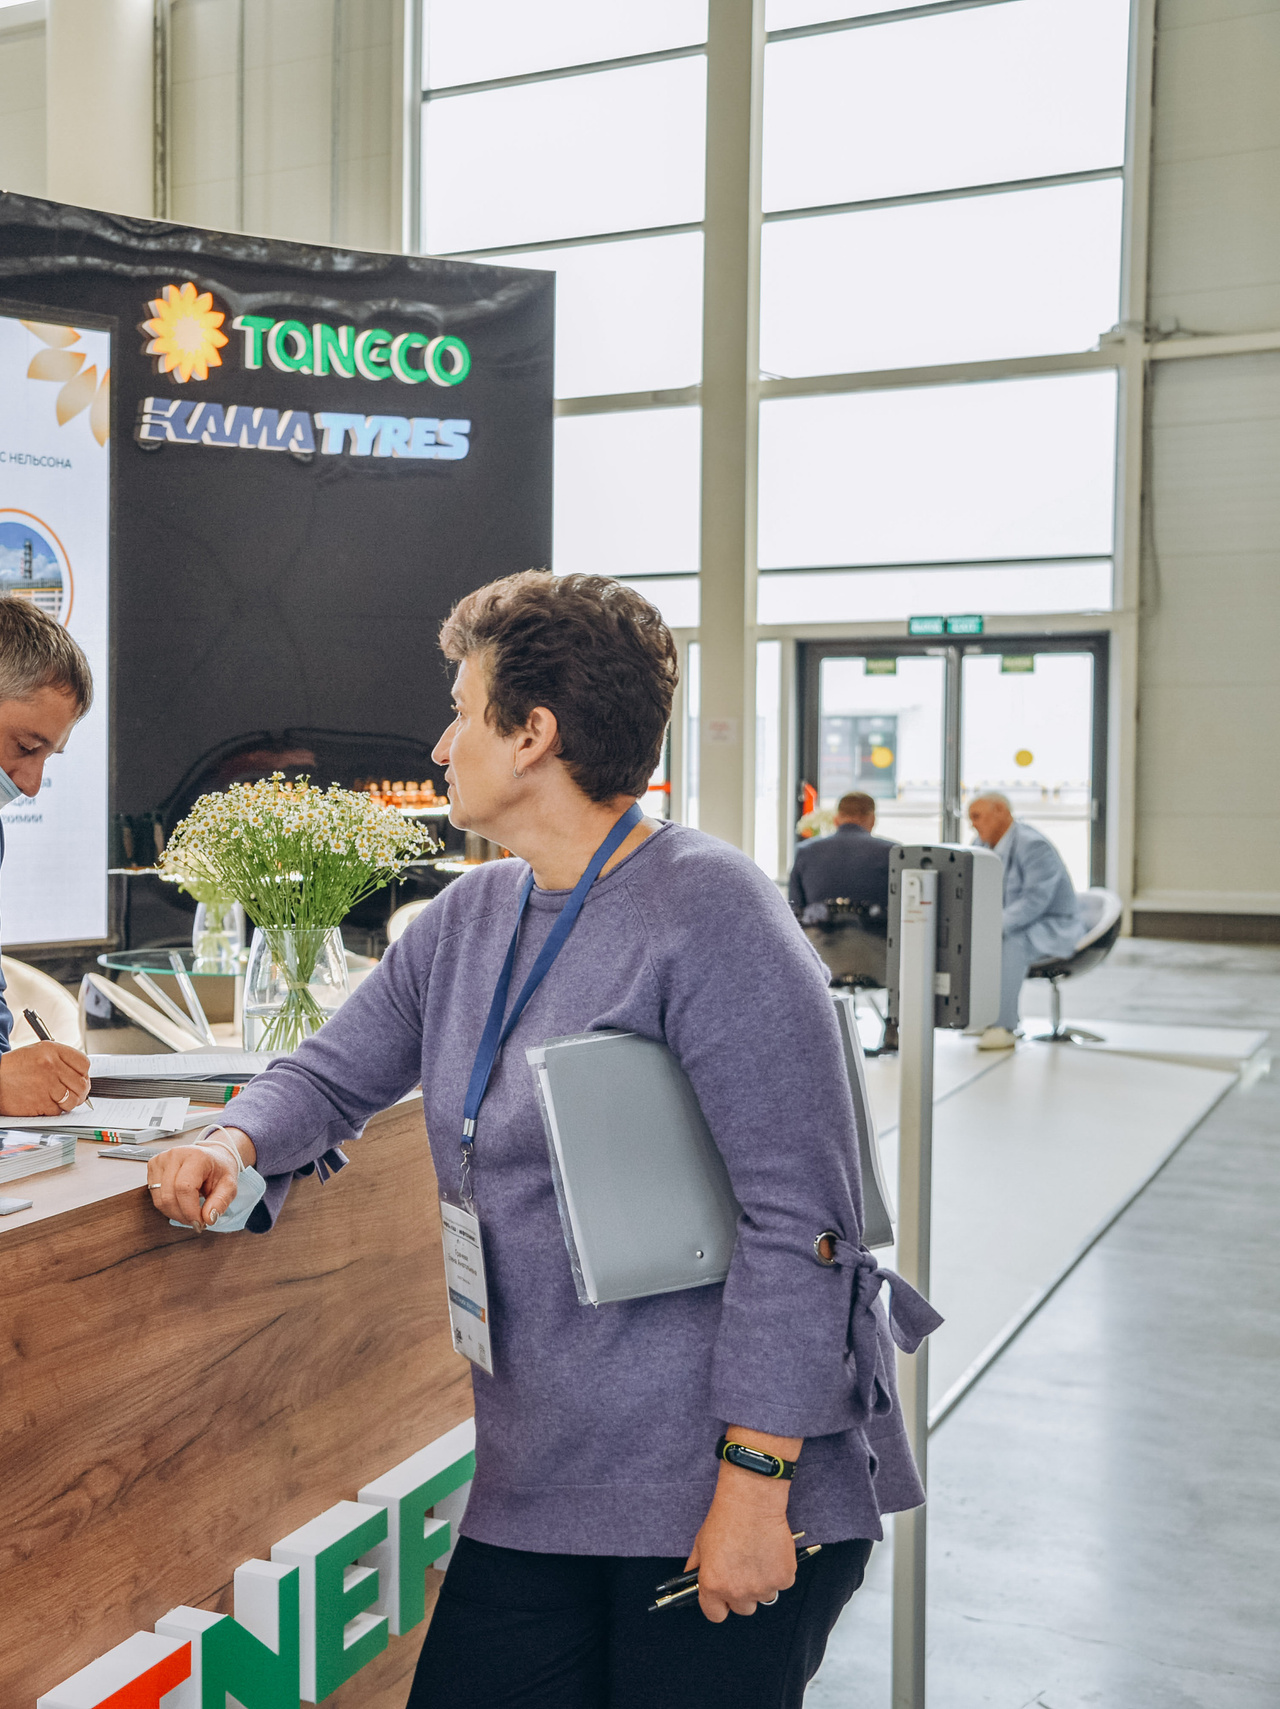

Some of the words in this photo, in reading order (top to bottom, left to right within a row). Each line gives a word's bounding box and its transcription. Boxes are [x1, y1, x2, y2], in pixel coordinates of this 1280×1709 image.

[232, 314, 472, 387] TANECO
[8, 453, 73, 469] НЕЛЬСОНА
[138, 396, 317, 454] KAMA
[314, 412, 471, 461] TYRES
